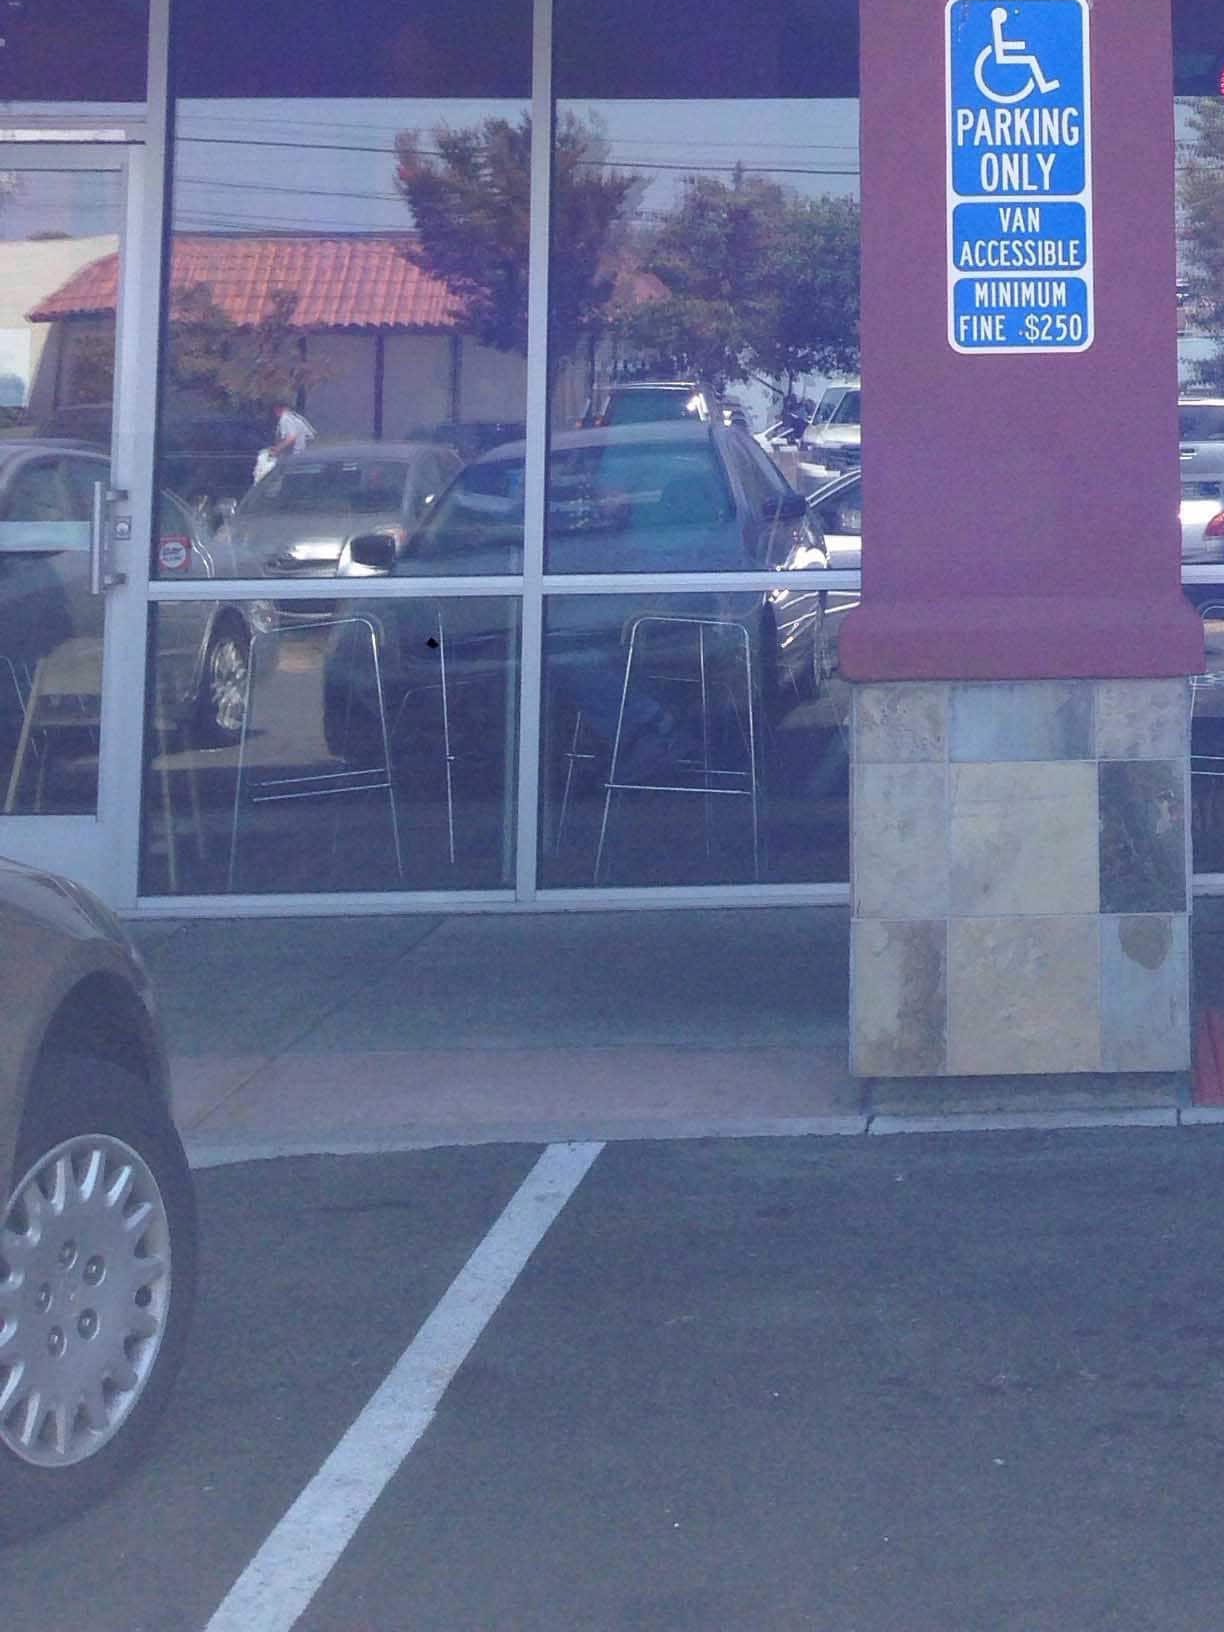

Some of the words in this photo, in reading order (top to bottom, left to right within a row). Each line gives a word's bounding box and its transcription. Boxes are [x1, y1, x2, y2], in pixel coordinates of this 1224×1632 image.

[956, 107, 1080, 147] PARKING
[980, 153, 1057, 192] ONLY
[998, 207, 1041, 233] VAN
[959, 239, 1081, 267] ACCESSIBLE
[974, 281, 1067, 309] MINIMUM
[959, 315, 1007, 342] FINE
[1024, 313, 1083, 344] $250
